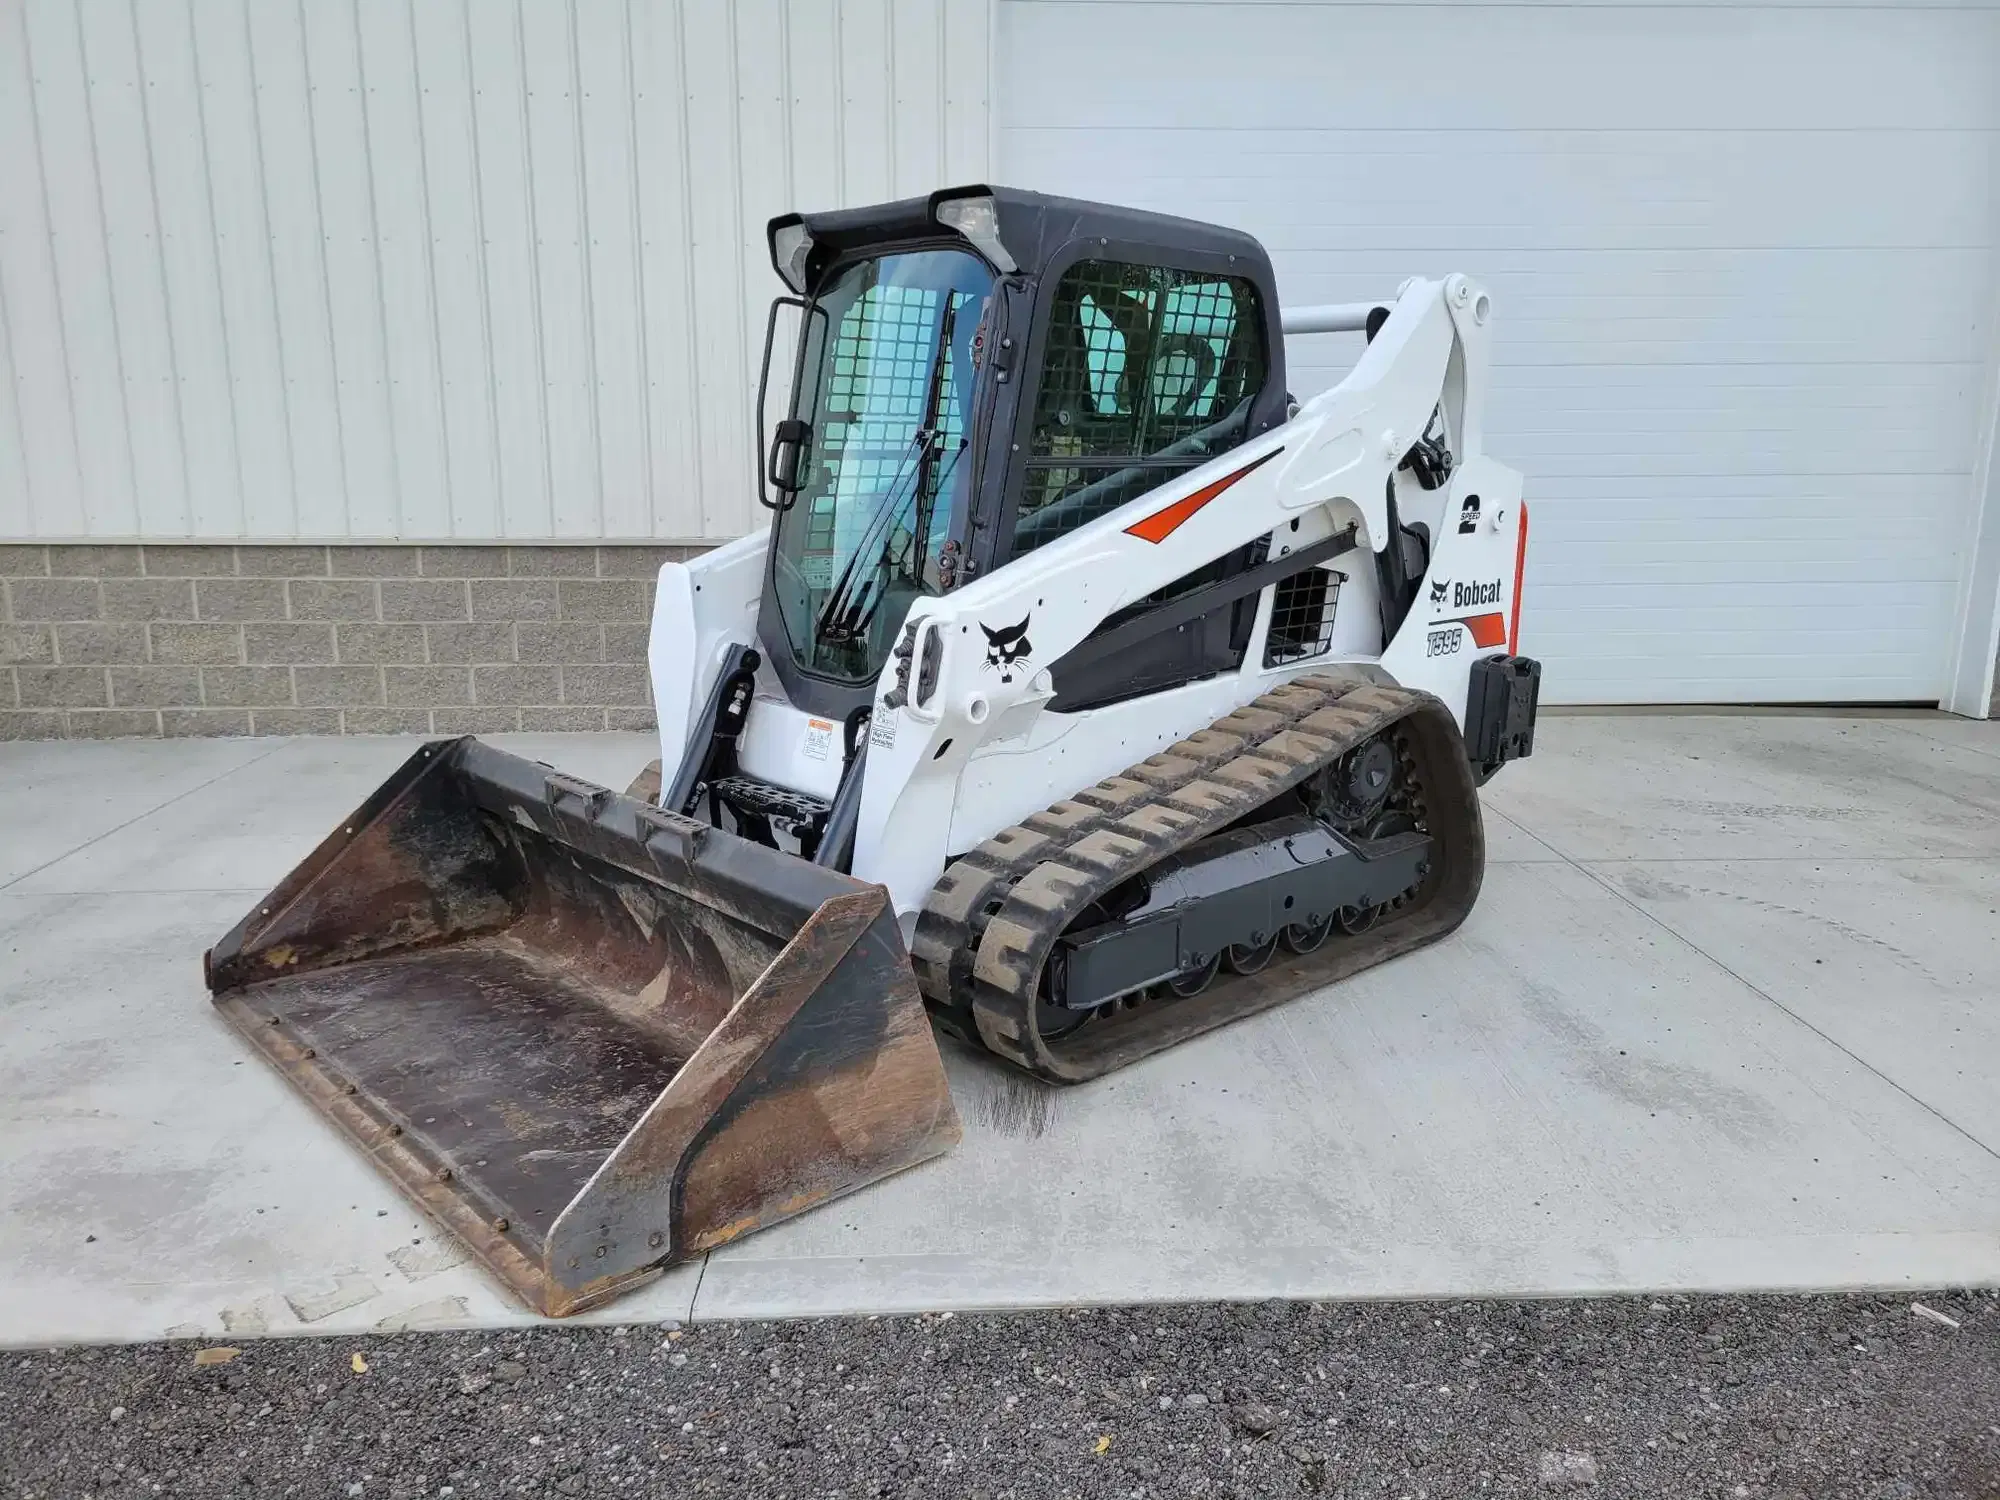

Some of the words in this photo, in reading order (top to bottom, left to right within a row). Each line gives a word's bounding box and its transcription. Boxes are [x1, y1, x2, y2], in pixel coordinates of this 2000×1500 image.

[1458, 494, 1480, 534] 2
[1460, 511, 1481, 521] SPEED
[1454, 578, 1501, 608] Bobcat
[1427, 628, 1463, 657] T595
